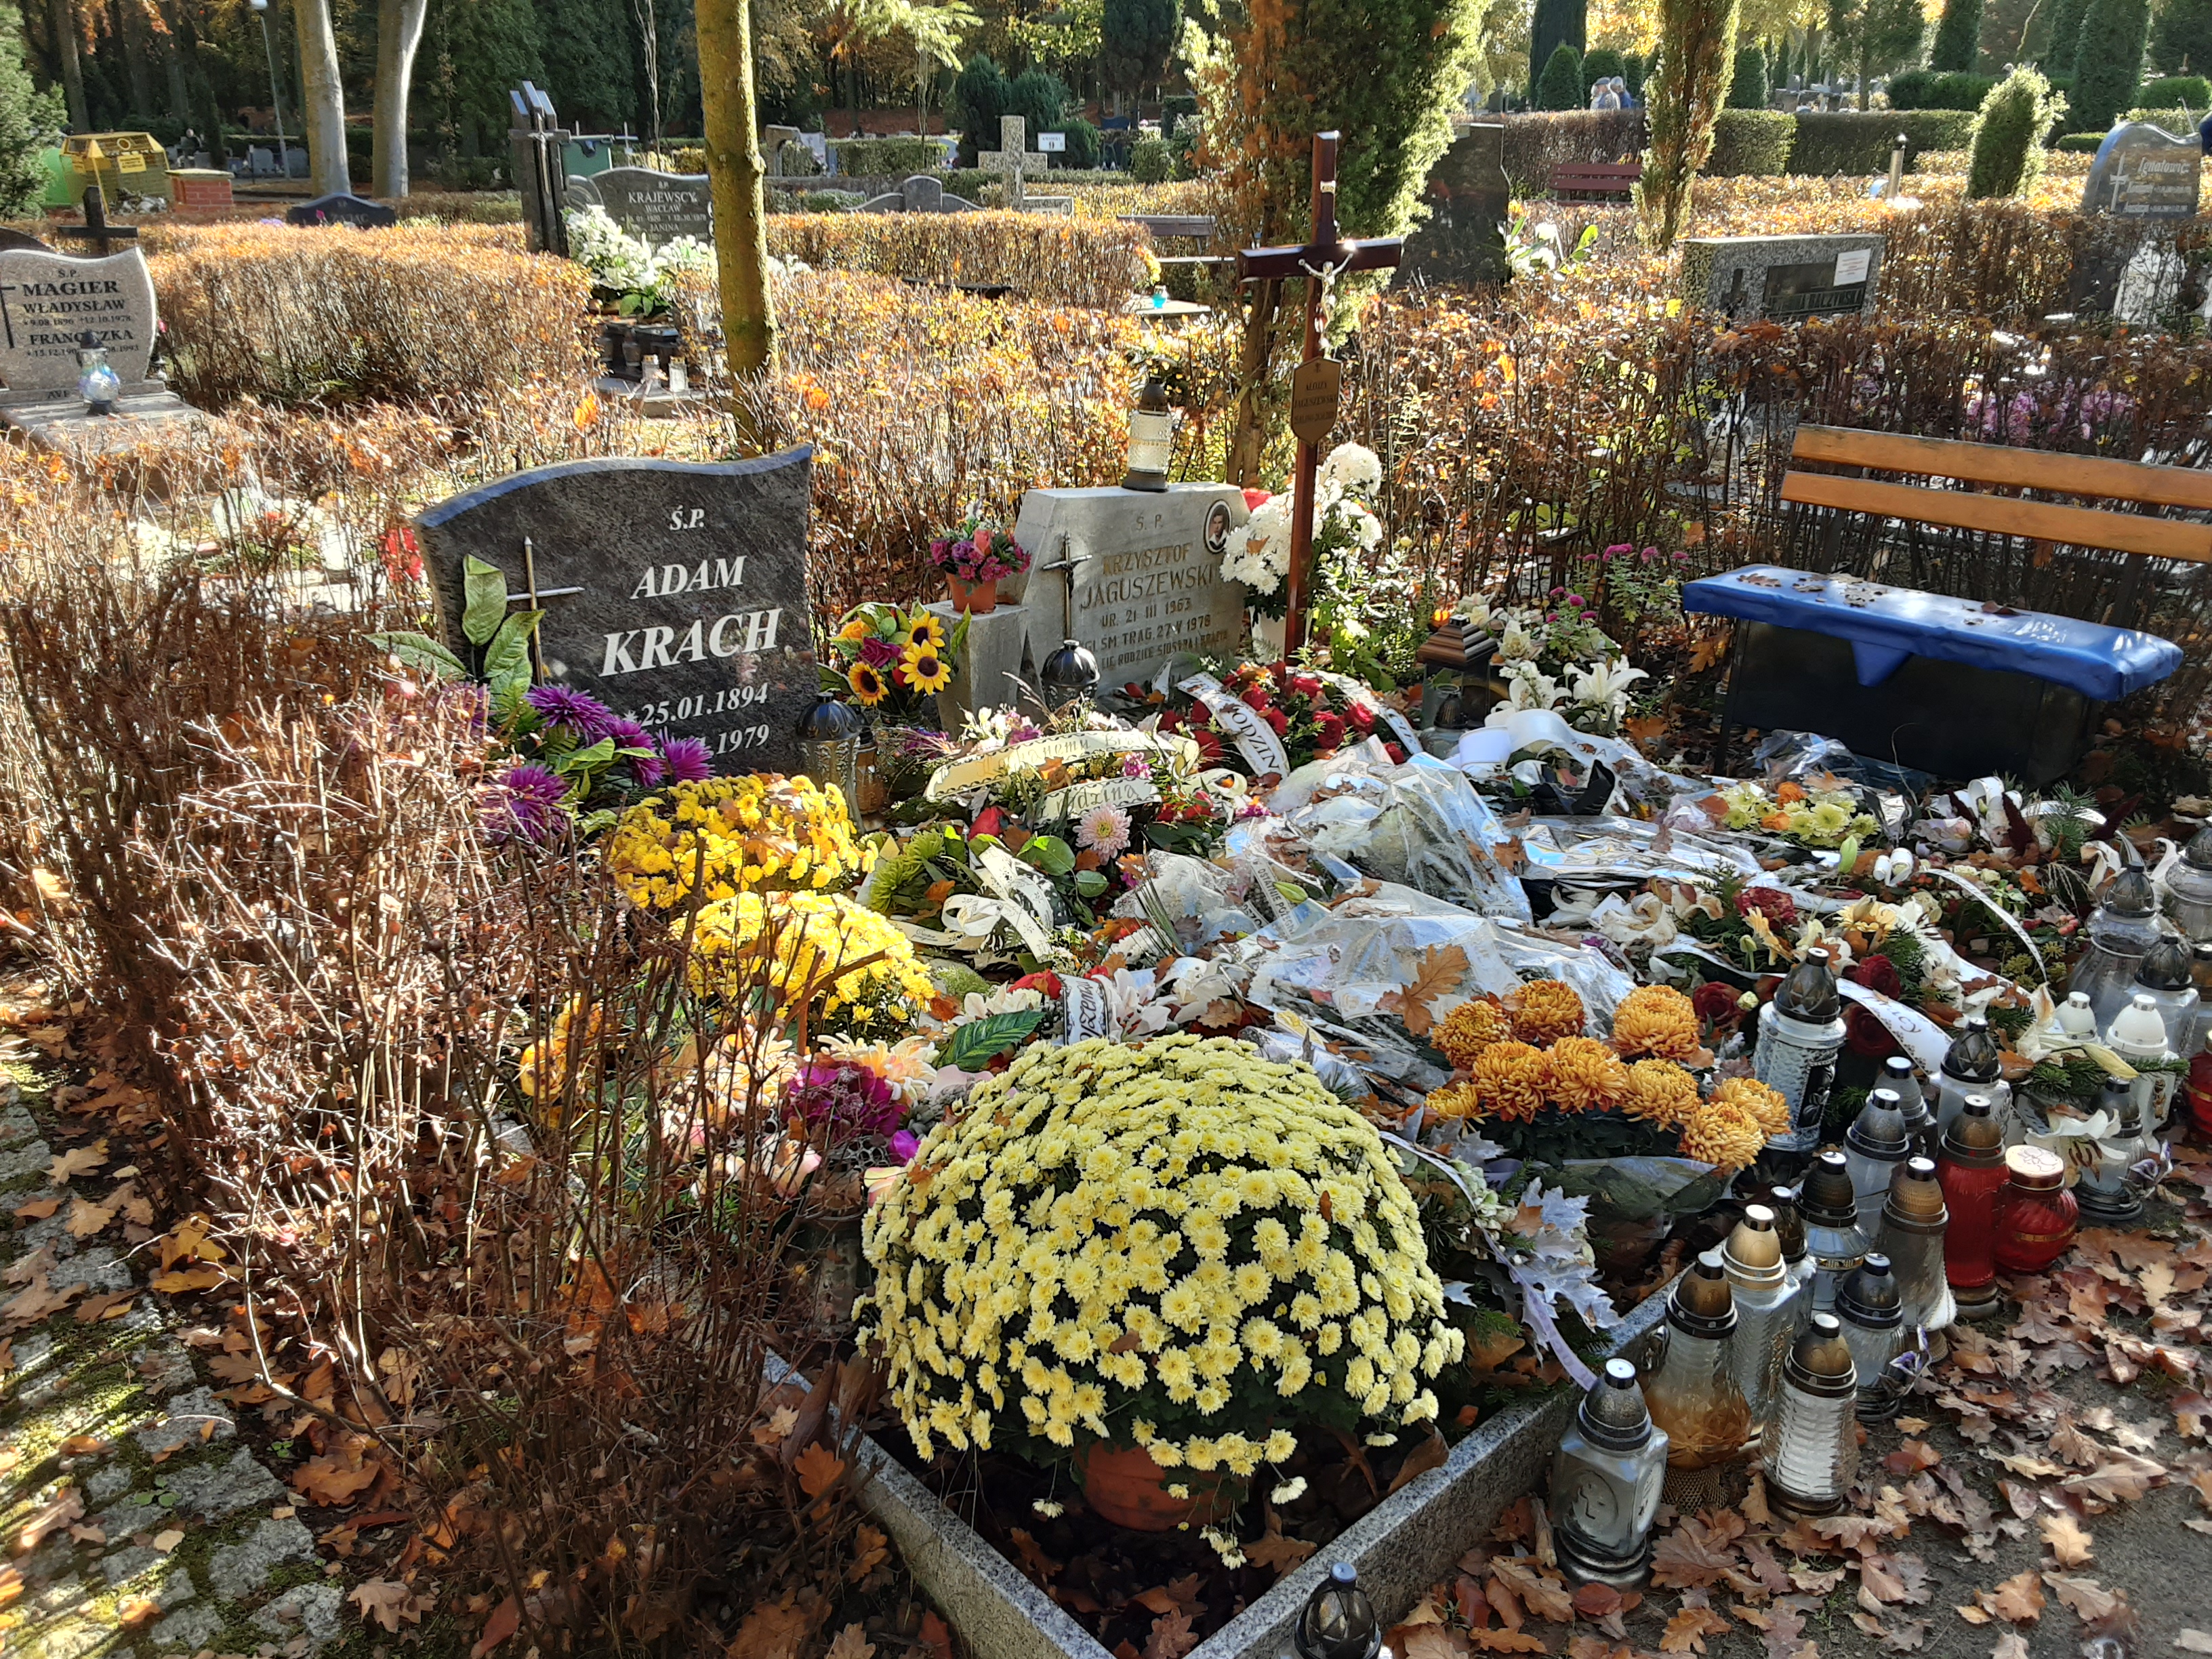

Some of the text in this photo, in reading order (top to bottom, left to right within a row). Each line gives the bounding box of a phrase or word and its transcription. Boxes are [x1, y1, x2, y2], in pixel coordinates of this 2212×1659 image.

[650, 223, 679, 232] JANINA
[22, 280, 121, 297] MAGIER
[23, 300, 126, 314] WŁADYSŁAW
[669, 505, 705, 531] Ś.P.
[1103, 542, 1193, 575] KRZYSZTOF
[630, 555, 747, 600] ADAM
[1080, 564, 1214, 611] JAGUSZEWSKI
[598, 608, 783, 678] KRACH
[640, 682, 769, 728] 25.01.1894
